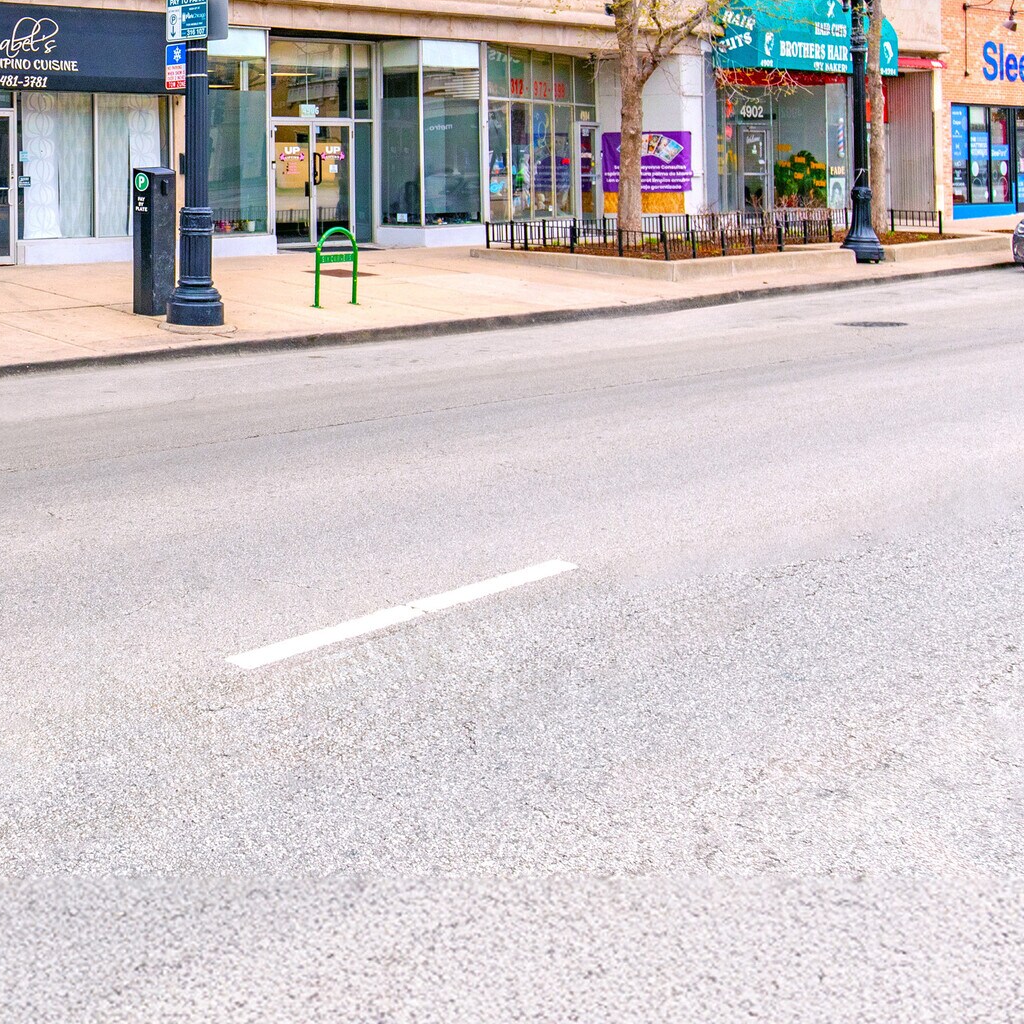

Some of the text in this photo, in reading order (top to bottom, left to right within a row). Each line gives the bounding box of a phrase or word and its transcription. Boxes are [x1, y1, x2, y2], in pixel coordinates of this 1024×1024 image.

[722, 10, 757, 31] HAIR
[779, 40, 826, 61] BROTHERS
[827, 44, 849, 62] HAIR
[33, 59, 80, 73] CUISINE
[510, 78, 524, 95] 312
[739, 104, 764, 119] 4902
[284, 146, 301, 155] UP
[325, 146, 341, 154] UP
[830, 165, 846, 176] FADE
